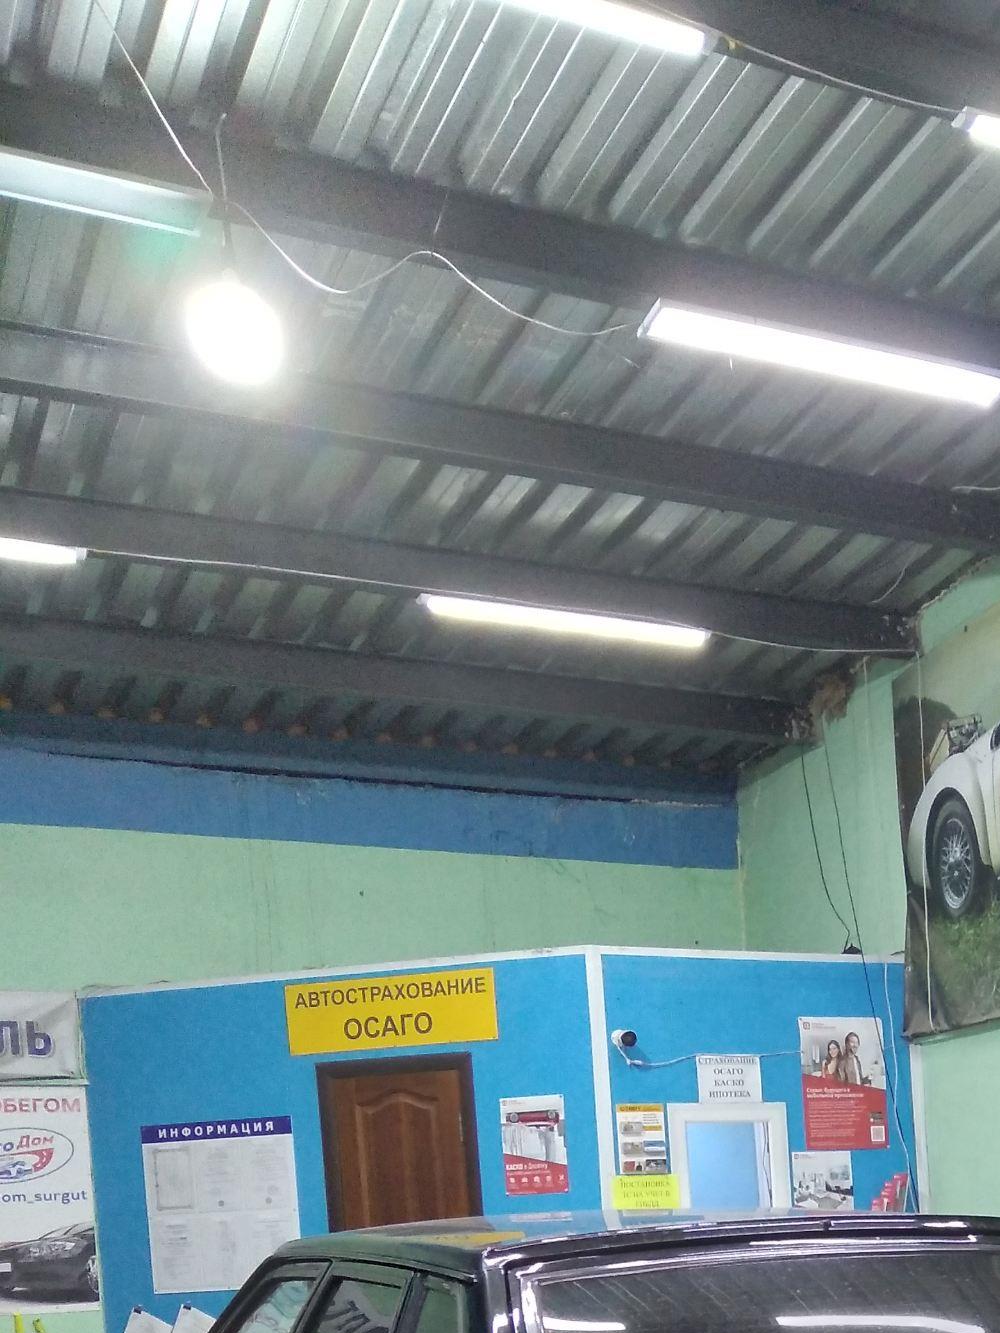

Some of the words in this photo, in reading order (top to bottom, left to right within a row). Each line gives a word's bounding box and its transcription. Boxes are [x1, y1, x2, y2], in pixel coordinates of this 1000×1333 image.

[295, 977, 486, 1009] АВТОСТРАХОВАНИЕ
[343, 1012, 433, 1040] ОСАГО
[0, 1098, 81, 1113] БЕГОМ
[158, 1121, 274, 1139] ИНФОРМАЦИЯ
